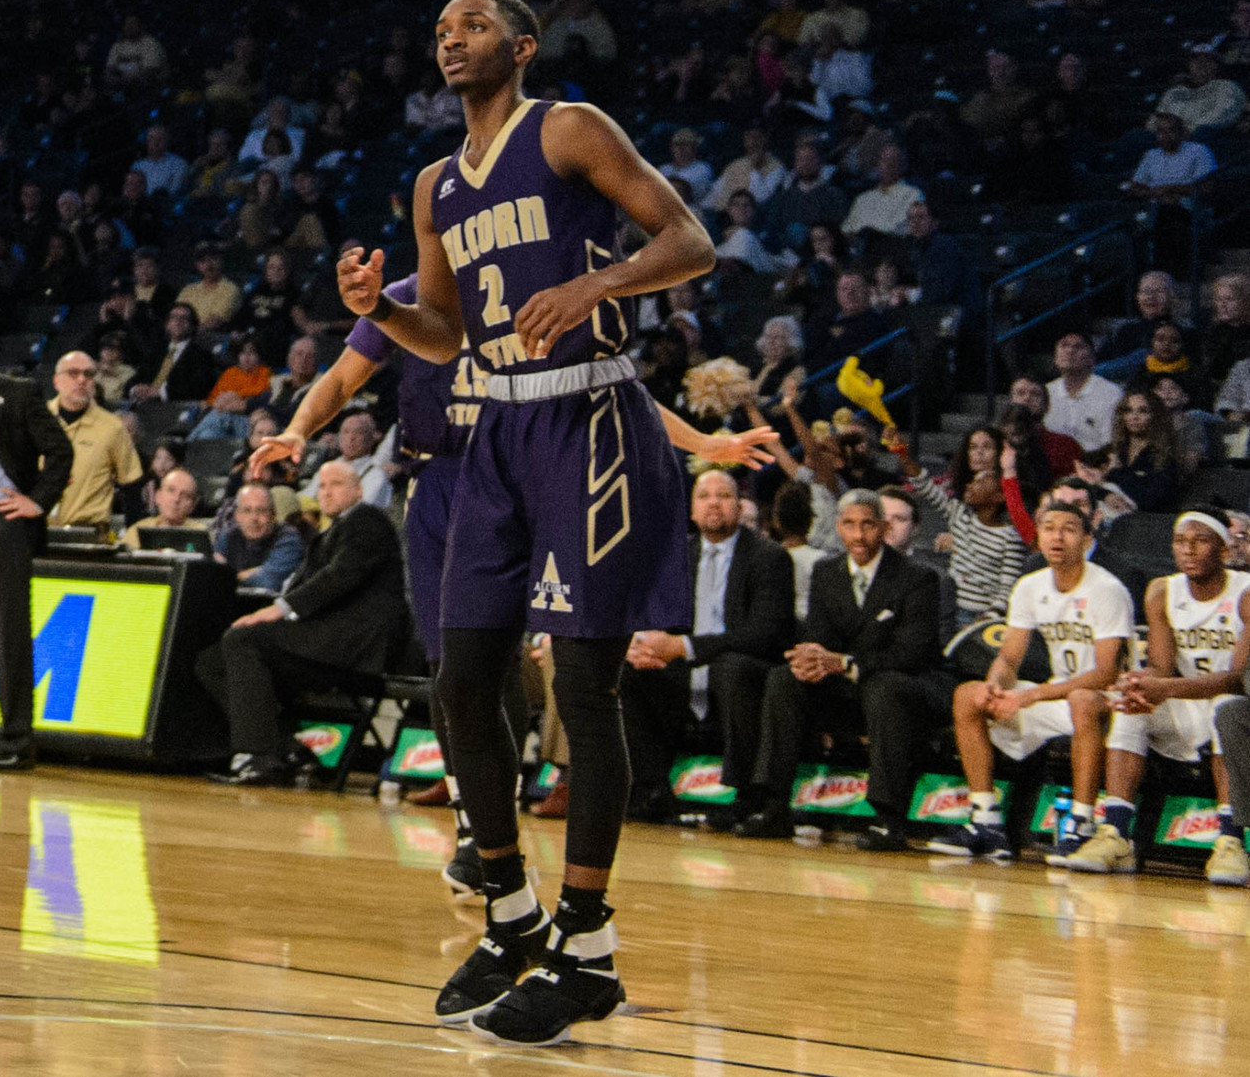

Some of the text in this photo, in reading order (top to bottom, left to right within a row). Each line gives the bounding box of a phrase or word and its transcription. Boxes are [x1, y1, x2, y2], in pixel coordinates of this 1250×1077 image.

[478, 263, 511, 327] 2
[1174, 627, 1236, 651] EORGIA
[1063, 649, 1077, 673] 0
